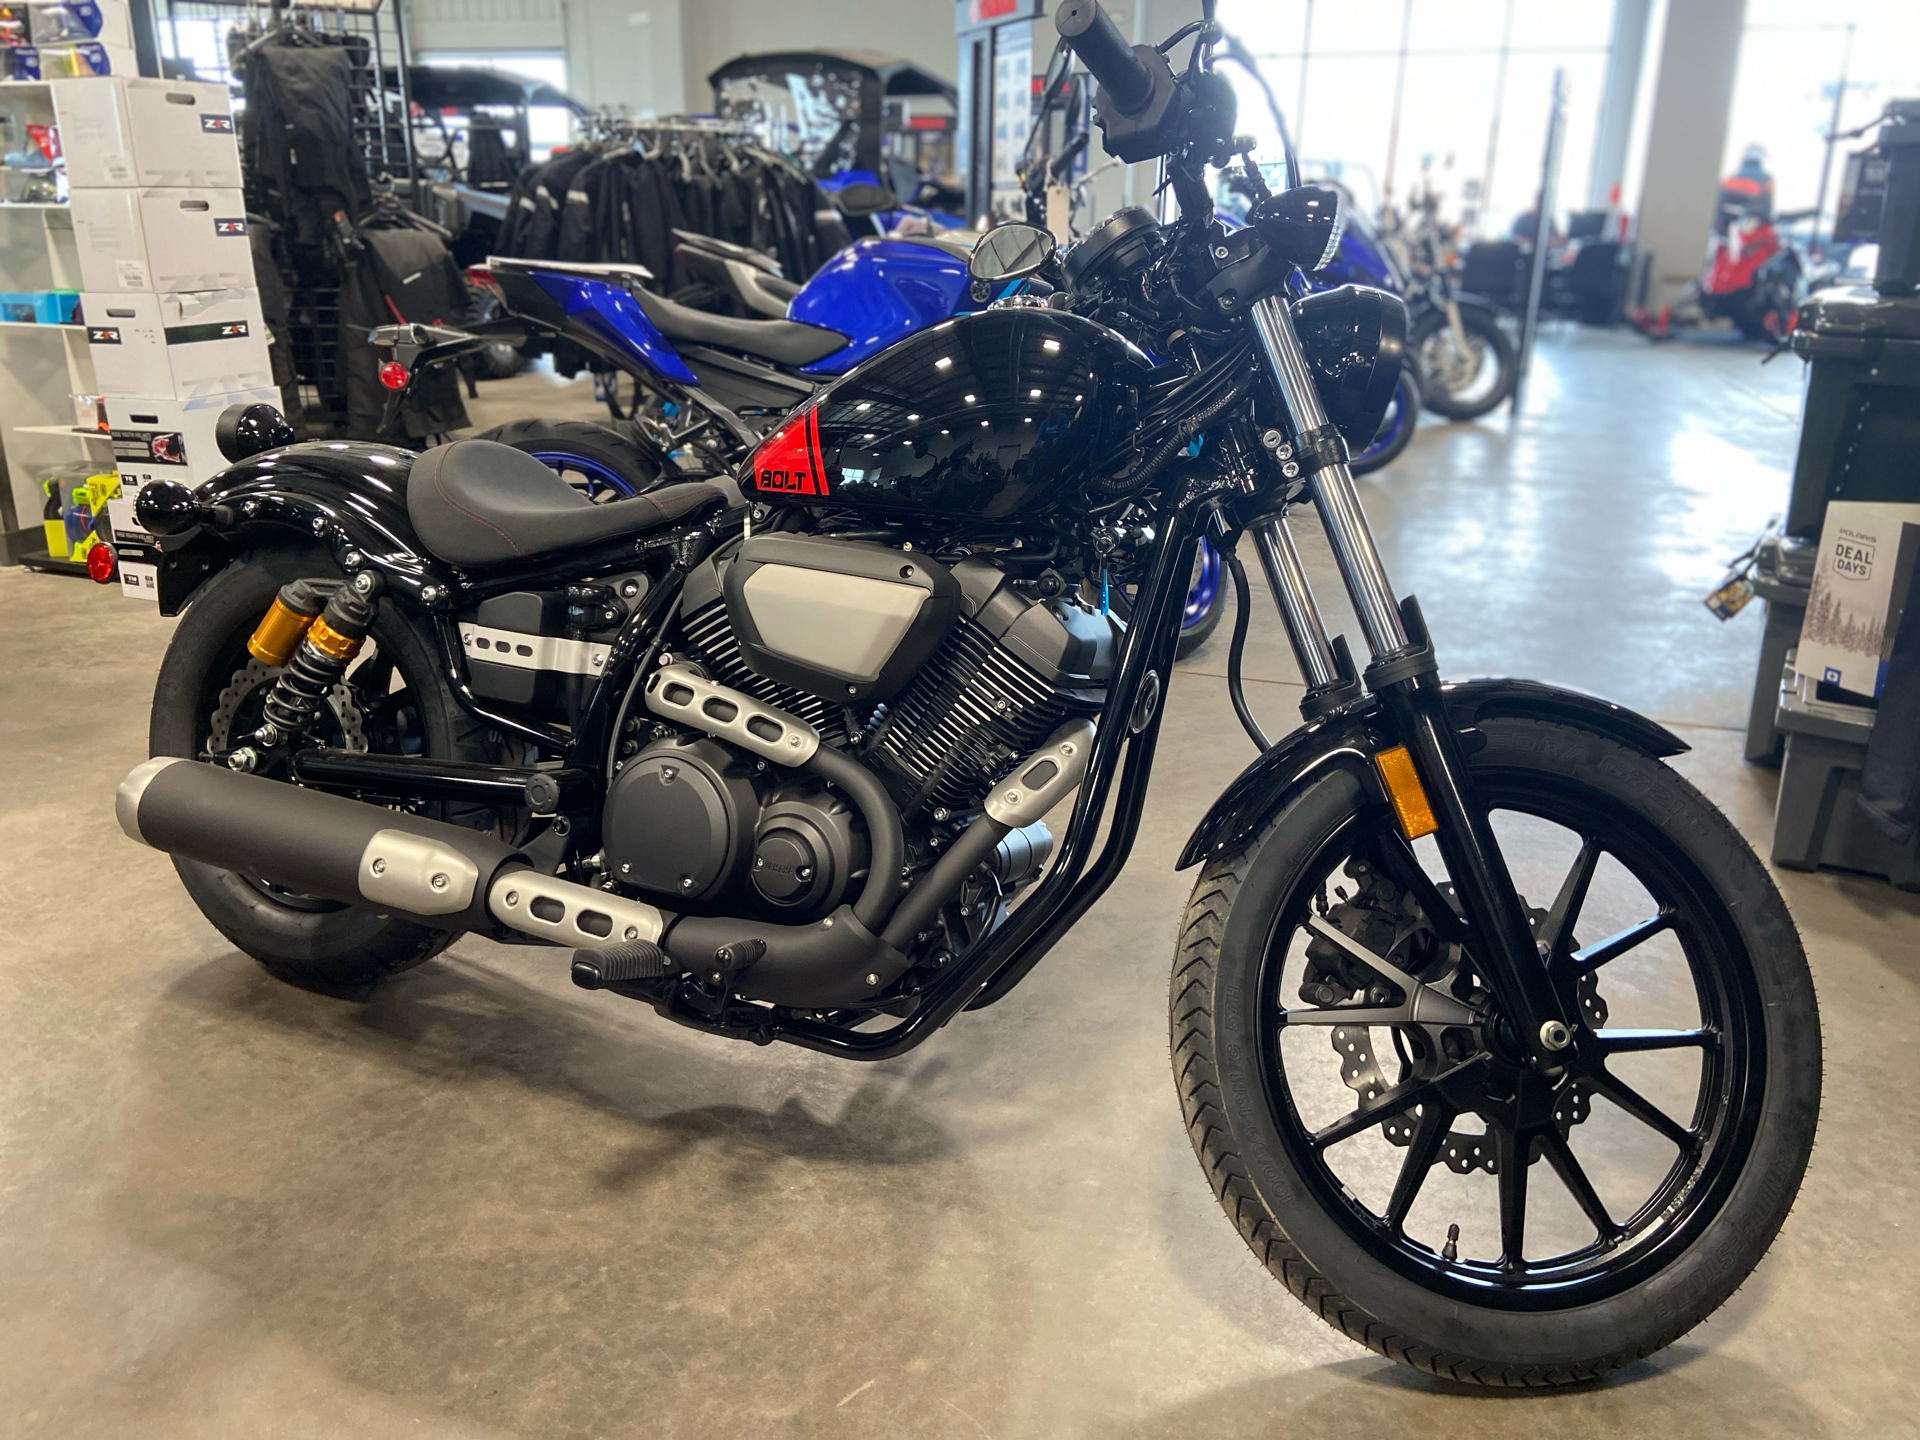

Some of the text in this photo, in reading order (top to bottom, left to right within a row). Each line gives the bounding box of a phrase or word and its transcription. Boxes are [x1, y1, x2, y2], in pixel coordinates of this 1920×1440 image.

[204, 119, 231, 129] Z1R
[218, 222, 245, 232] Z1R
[93, 330, 120, 340] Z1R
[221, 325, 247, 335] Z1R
[760, 469, 807, 491] BOLT
[1839, 528, 1877, 543] POLARIS
[1835, 543, 1873, 566] DEAL
[1837, 558, 1867, 576] DAYS
[1486, 731, 1588, 764] EDRA
[1224, 983, 1241, 1032] 57H
